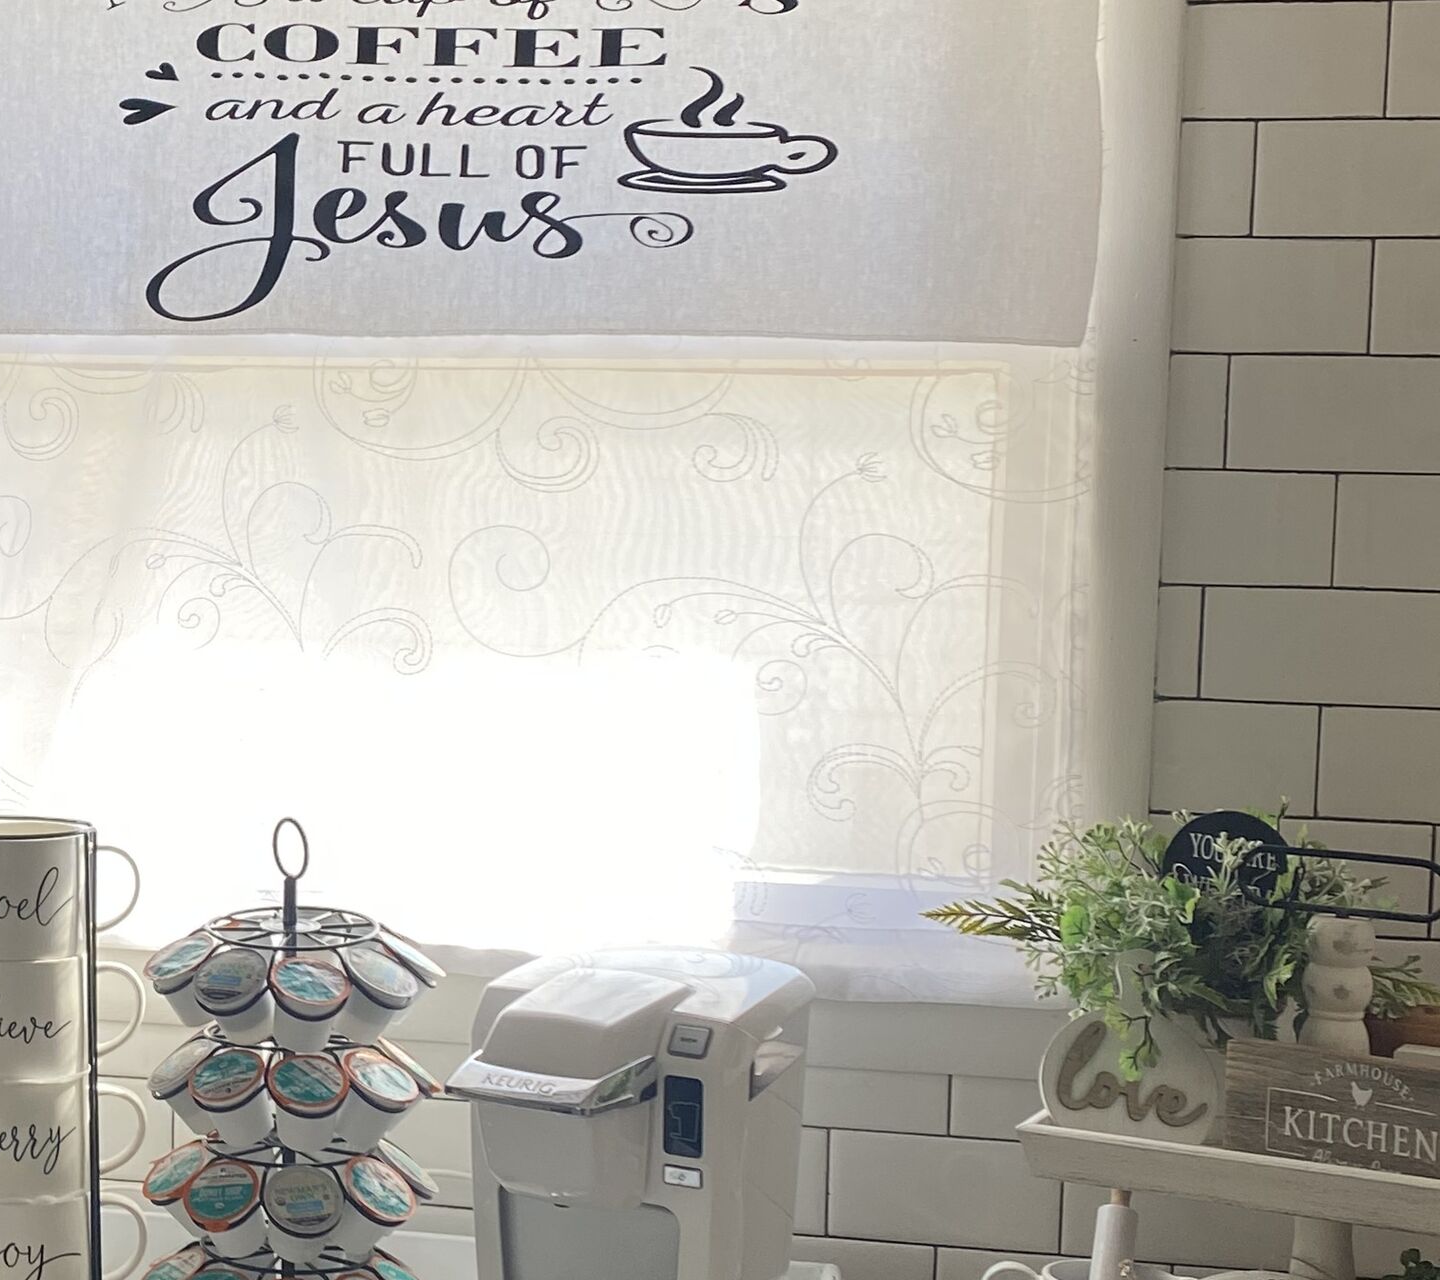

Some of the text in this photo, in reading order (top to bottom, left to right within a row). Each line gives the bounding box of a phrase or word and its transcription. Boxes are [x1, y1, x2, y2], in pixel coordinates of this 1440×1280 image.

[195, 22, 668, 69] COFFEE
[205, 87, 615, 127] and a heart
[337, 139, 589, 181] FULL OF
[145, 132, 590, 322] Jesus
[481, 1072, 558, 1096] KEURIG
[1056, 1020, 1209, 1128] love
[1313, 1062, 1411, 1101] FARMHOUSE
[1283, 1106, 1439, 1163] KITCHEN
